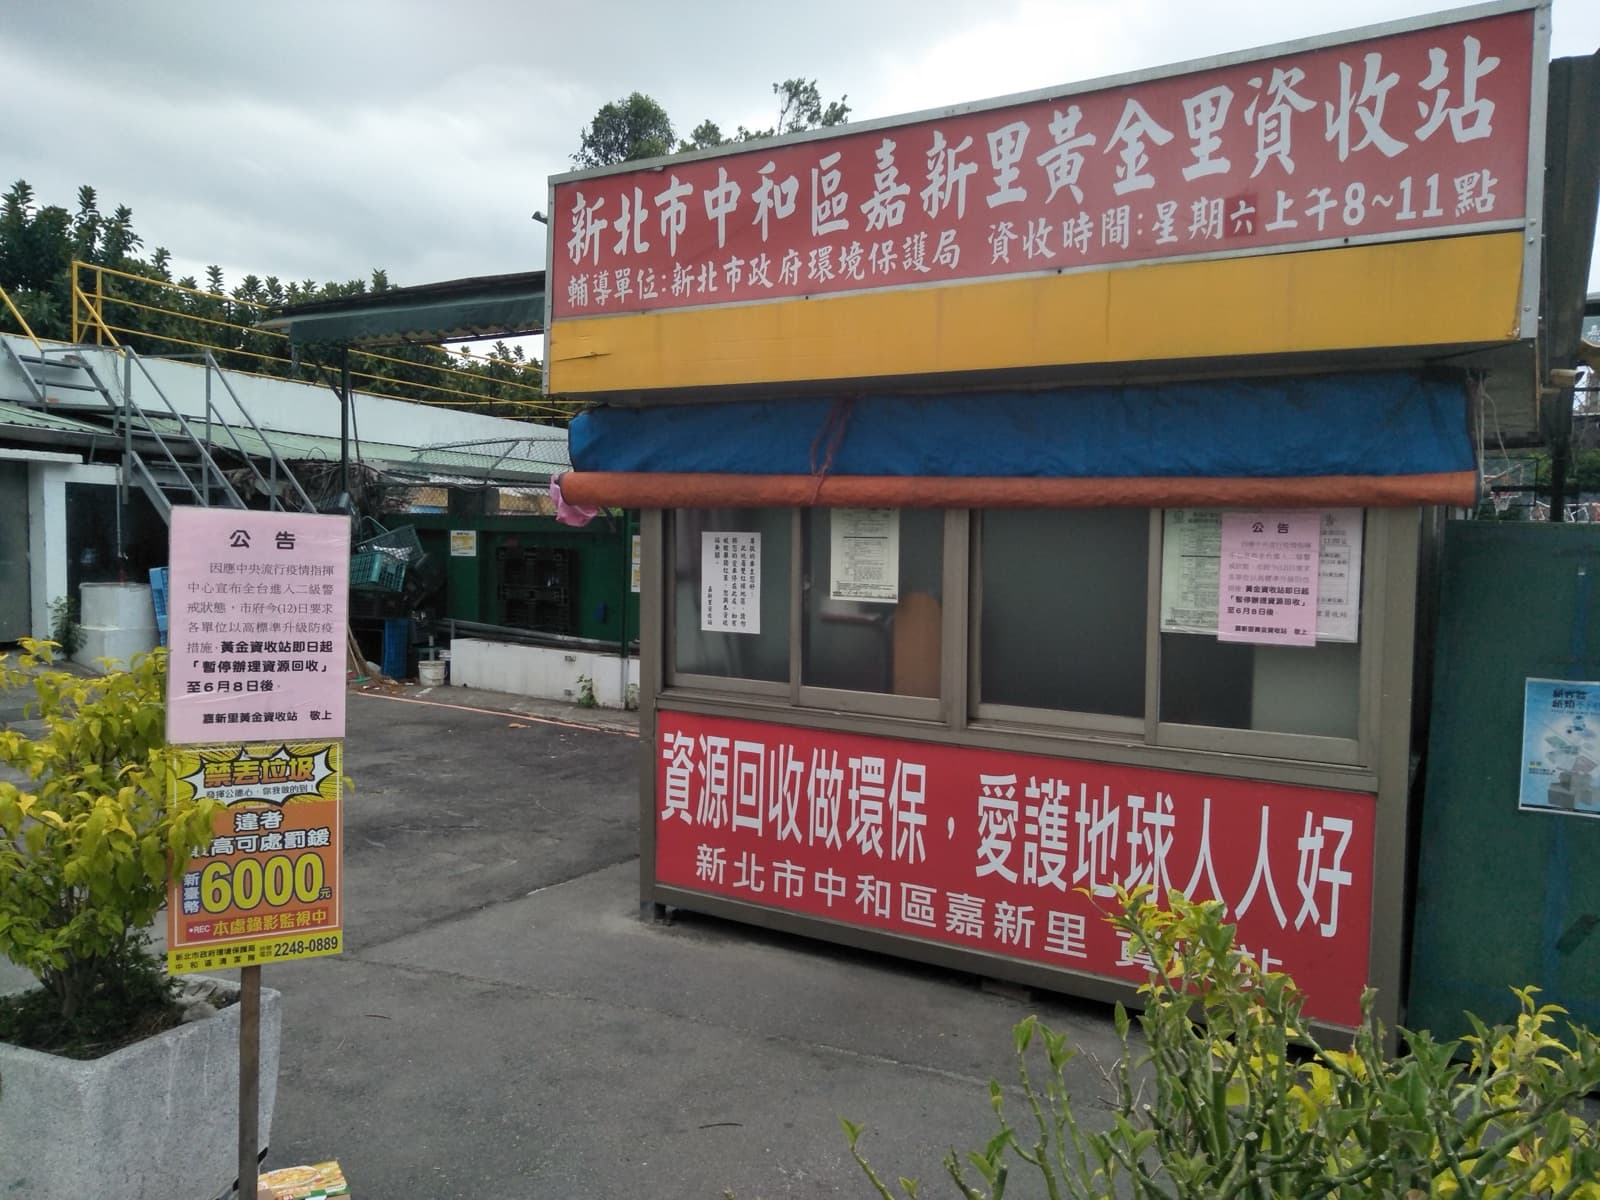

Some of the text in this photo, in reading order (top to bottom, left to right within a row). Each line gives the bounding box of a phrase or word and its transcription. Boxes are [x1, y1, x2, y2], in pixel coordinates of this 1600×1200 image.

[567, 35, 1501, 266] 新北市中和區嘉新里黃金里資收站
[209, 563, 335, 577] 因應中央流行疫情指揮
[187, 582, 334, 596] 中心宣布全台進入二級警
[188, 621, 334, 634] 各單位以高標準升級防疫
[202, 710, 332, 724] 嘉新里黃金資收站 敬上
[203, 756, 315, 788] 禁丟垃圾
[235, 810, 284, 832] 違者
[193, 909, 327, 937] REC 本處錄影監視中
[273, 937, 338, 957] 2248-0889
